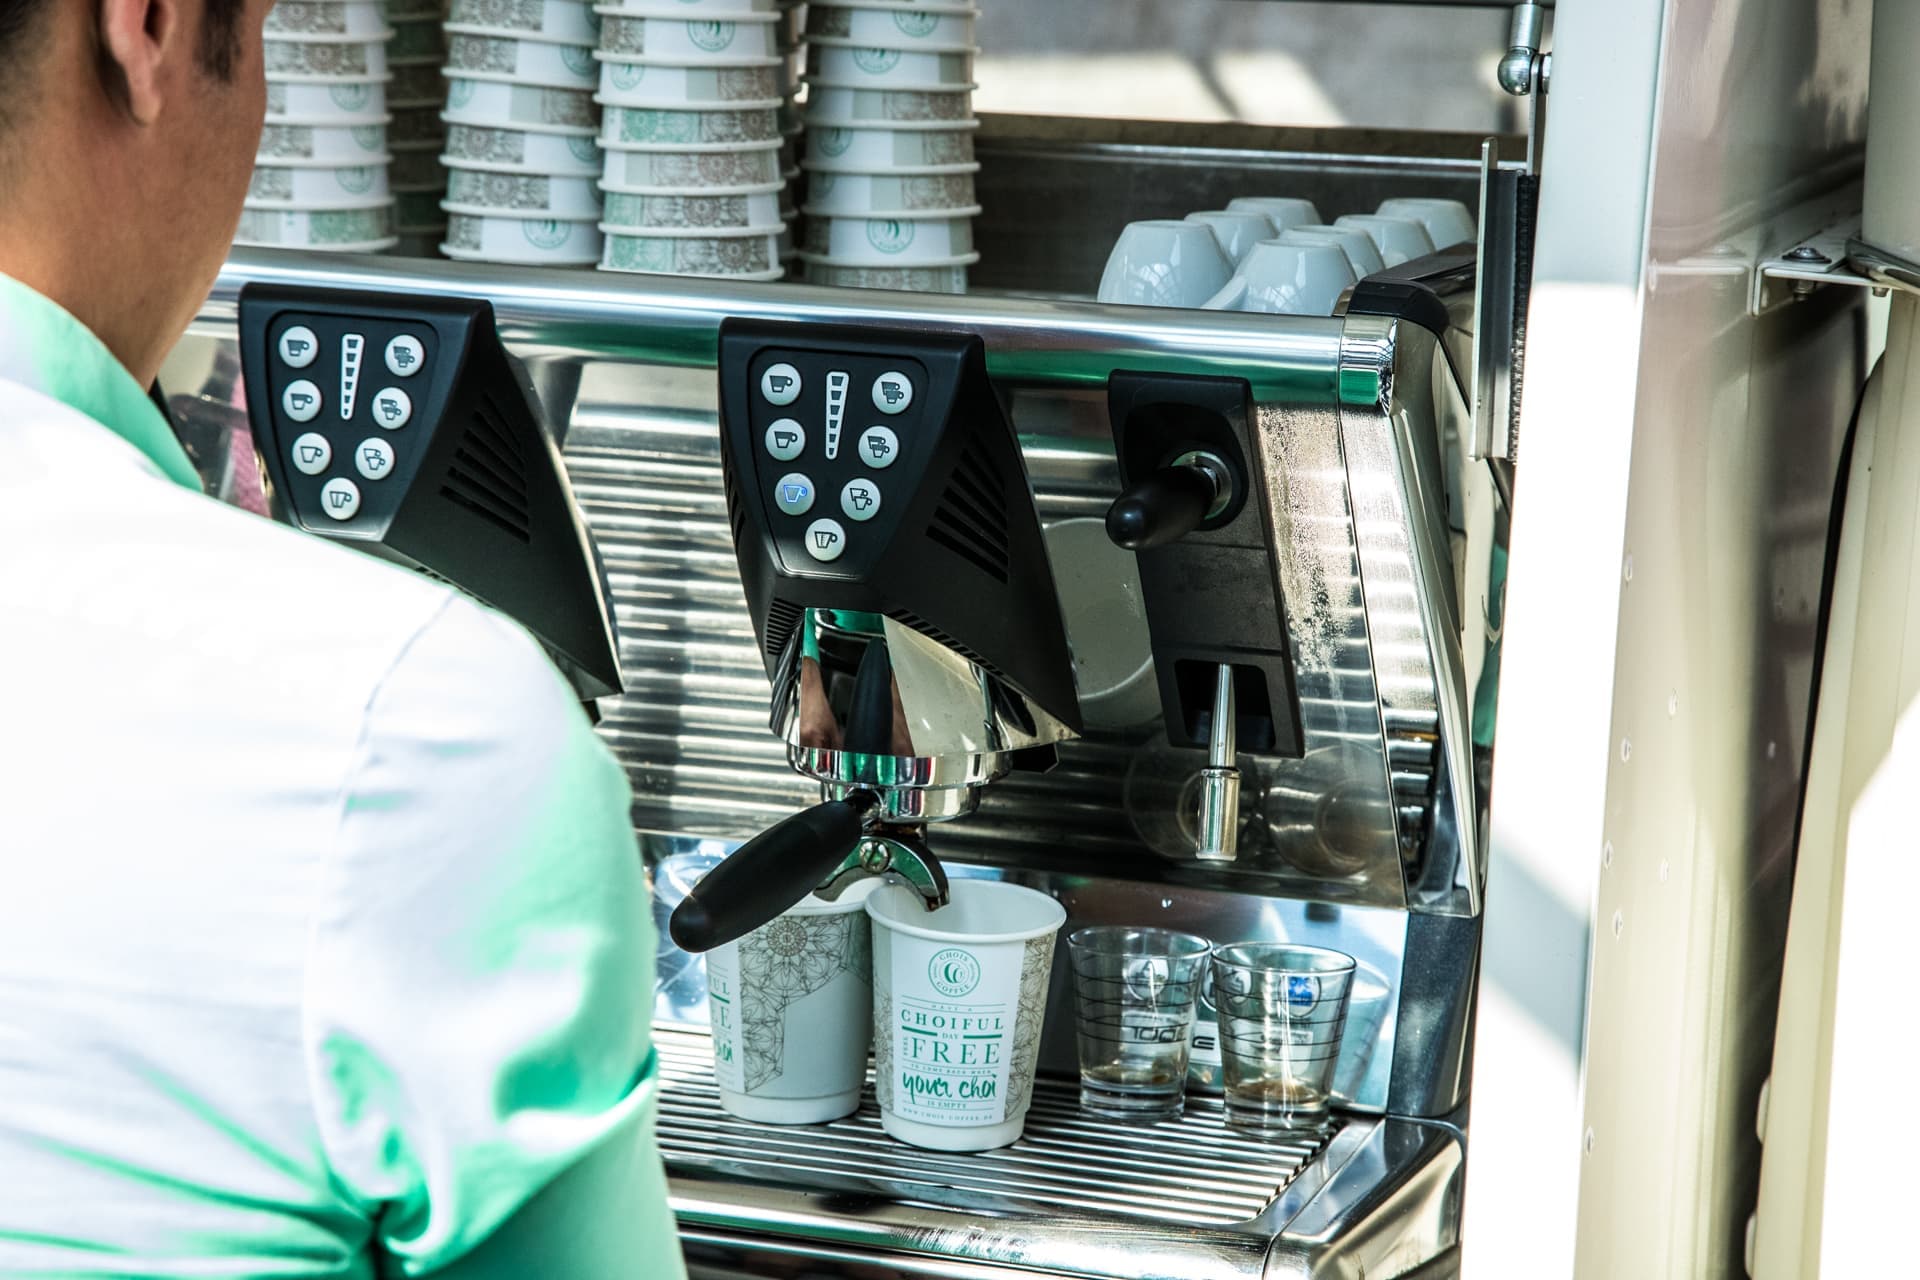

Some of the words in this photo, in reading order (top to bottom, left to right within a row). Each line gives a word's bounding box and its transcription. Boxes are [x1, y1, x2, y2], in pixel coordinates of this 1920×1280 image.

[901, 1009, 1004, 1031] CHOIFUL
[942, 1032, 960, 1040] DAY
[911, 1037, 1000, 1065] FREE
[902, 1071, 953, 1105] your
[959, 1073, 997, 1099] choi
